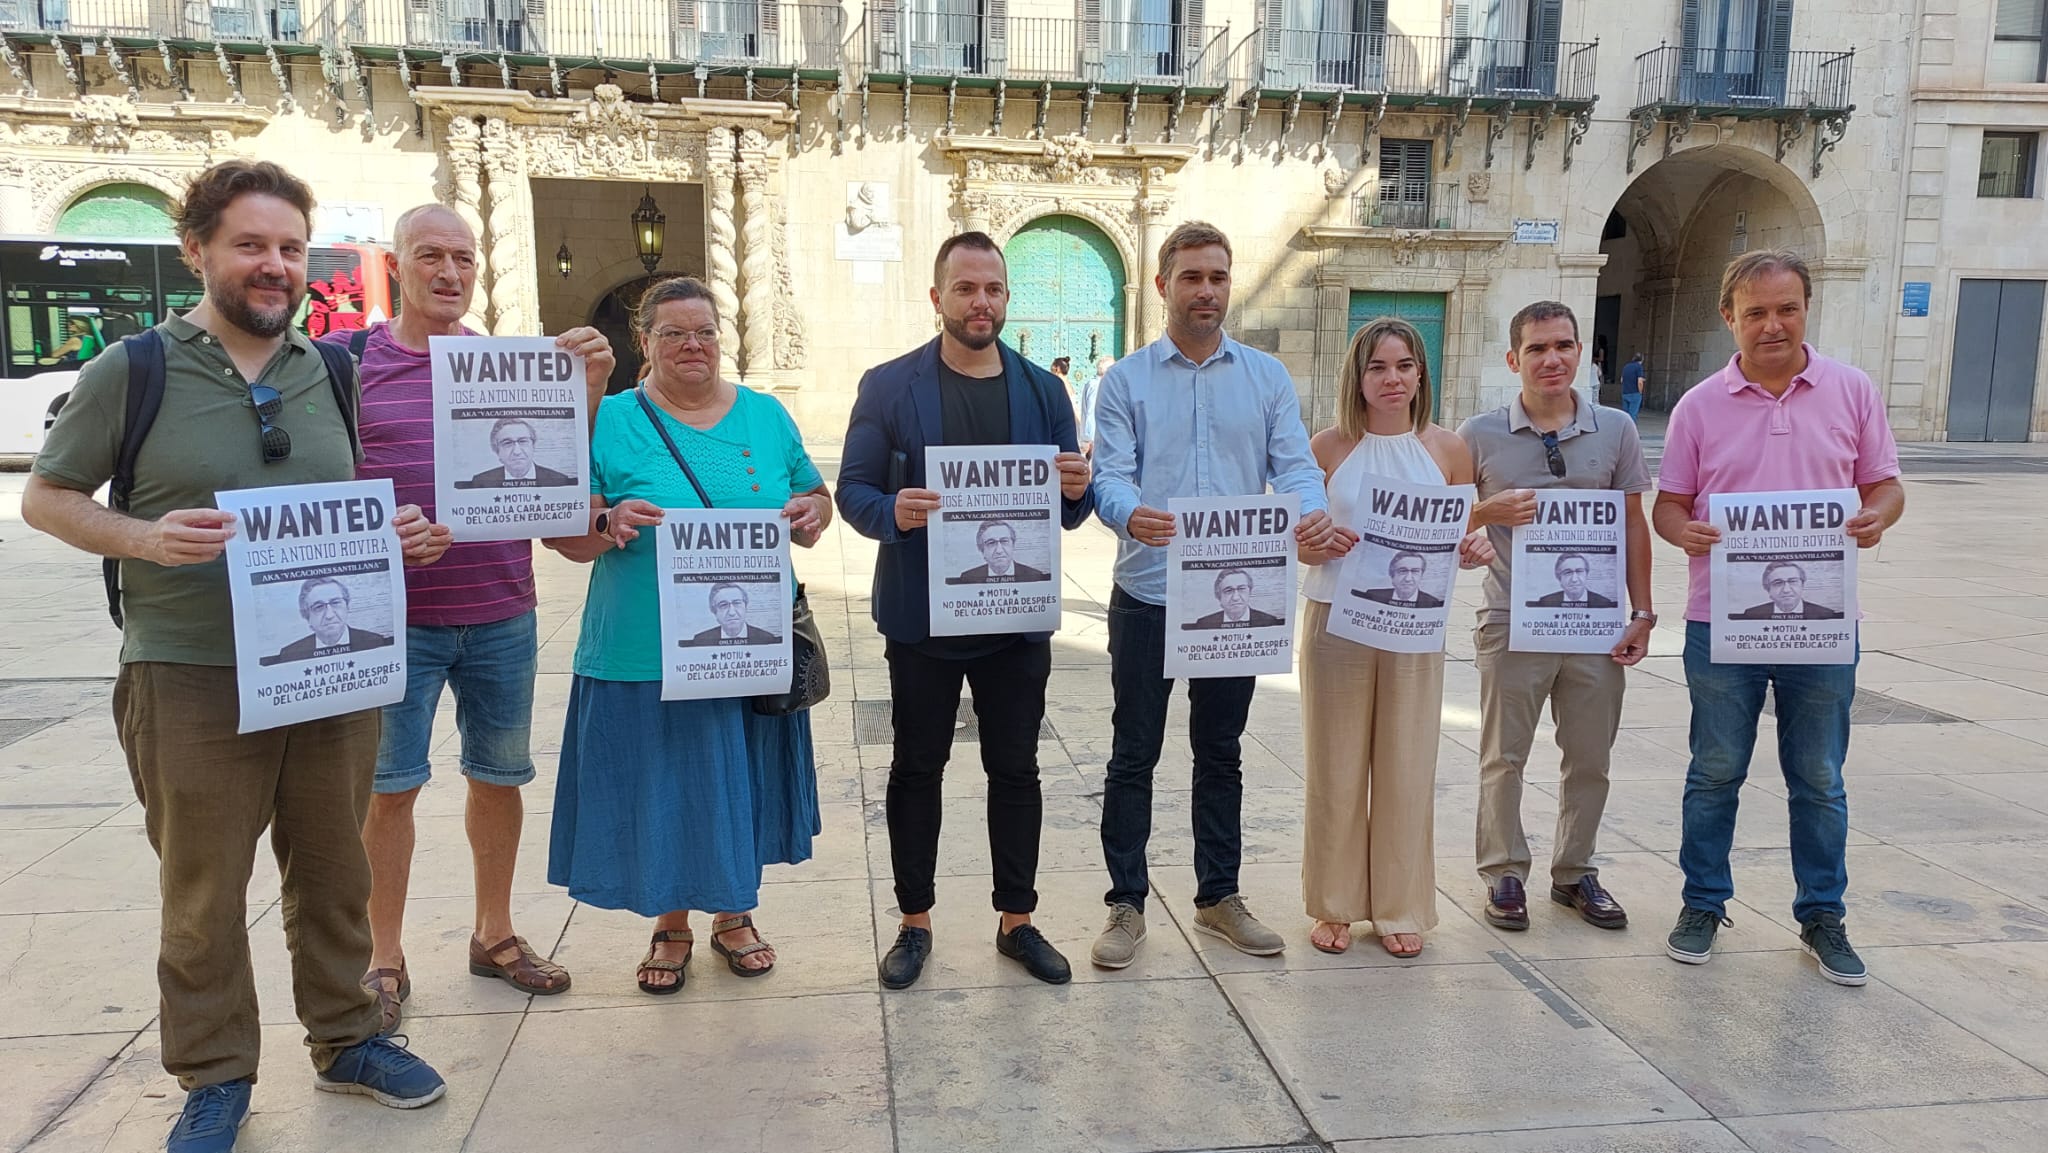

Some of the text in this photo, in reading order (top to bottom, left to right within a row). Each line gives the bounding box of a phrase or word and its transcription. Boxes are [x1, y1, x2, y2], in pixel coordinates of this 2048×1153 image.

[448, 352, 572, 383] WANTED
[449, 388, 575, 404] JOSÉ ANTONIO ROVIRA
[940, 459, 1049, 488] WANTED
[504, 494, 531, 502] MOTIU
[942, 492, 1050, 507] JOSÉ ANTONIO ROVIRA
[1373, 488, 1464, 523] WANTED
[468, 506, 500, 515] DONAR
[503, 505, 514, 513] LA
[517, 504, 541, 512] CARA
[1725, 502, 1844, 531] WANTED
[240, 497, 384, 542] WANTED
[466, 516, 482, 524] DEL
[486, 515, 510, 523] CAOS
[514, 514, 525, 522] EN
[1182, 508, 1288, 538] WANTED
[1364, 518, 1459, 539] JOSÉ ANTONIO ROVIRA
[1524, 528, 1617, 541] JOSÉ ANTONIO ROVIRA
[671, 523, 779, 550] WANTED
[1725, 534, 1845, 549] JOSÉ ANTONIO ROVIRA
[246, 538, 389, 567] JOSÉ ANTONIO ROVIRA
[1180, 540, 1288, 556] JOSÉ ANTONIO ROVIRA
[672, 554, 780, 569] JOSÉ ANTONIO ROVIRA
[281, 567, 332, 578] "VACACIONES
[333, 561, 381, 573] SANTILLANA"
[987, 589, 1010, 597] MOTIU
[957, 600, 983, 608] DONAR
[986, 599, 995, 607] LA
[997, 598, 1018, 606] CARA
[955, 609, 969, 617] DEL
[971, 608, 992, 616] CAOS
[995, 607, 1005, 615] EN
[1343, 608, 1353, 616] NO
[1355, 611, 1381, 623] DONAR
[1387, 610, 1409, 619] MOTIU
[1352, 618, 1365, 627] DEL
[1367, 623, 1388, 632] CAOS
[314, 648, 330, 656] ONLY
[721, 652, 743, 660] MOTIU
[1205, 652, 1225, 660] CAOS
[315, 661, 345, 675] MOTIU
[690, 663, 716, 671] DONAR
[719, 662, 728, 670] LA
[731, 661, 751, 669] CARA
[258, 687, 272, 698] NO
[276, 680, 310, 694] DONAR
[314, 678, 326, 687] LA
[329, 672, 355, 684] CARA
[274, 695, 291, 705] DEL
[295, 688, 323, 701] CAOS
[326, 684, 338, 695] EN
